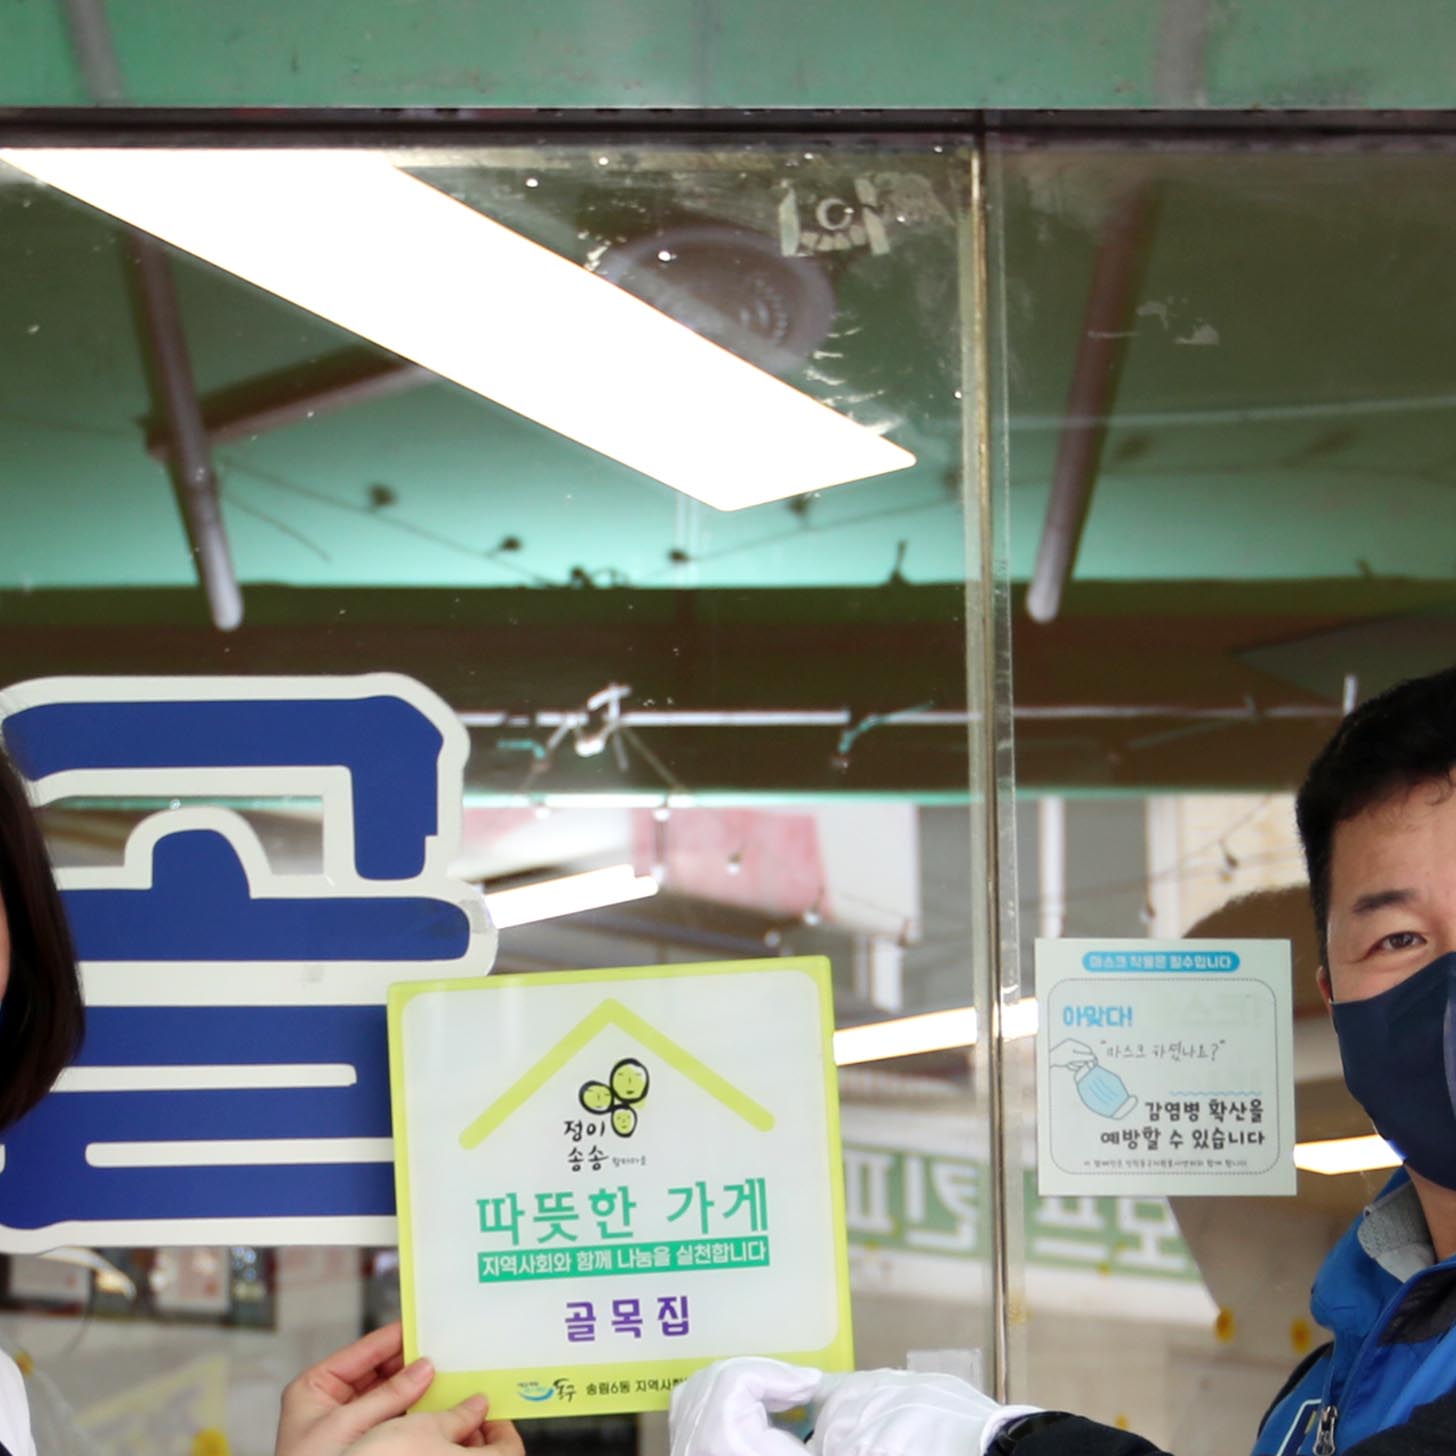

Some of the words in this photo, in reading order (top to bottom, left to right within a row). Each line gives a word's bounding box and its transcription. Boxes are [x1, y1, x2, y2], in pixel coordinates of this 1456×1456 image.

[1144, 1101, 1201, 1123] 감염병
[1208, 1099, 1264, 1124] 확산을
[563, 1119, 606, 1142] 정이
[1100, 1125, 1161, 1151] 예방할
[1169, 1129, 1184, 1149] 수
[1191, 1127, 1265, 1151] 있습니다
[567, 1144, 609, 1173] 송송
[476, 1185, 638, 1246] 따뜻한
[666, 1177, 769, 1236] 가게
[482, 1251, 572, 1277] 지역사회와
[576, 1249, 613, 1272] 함께
[617, 1246, 672, 1270] 나눔을
[675, 1240, 768, 1265] 실천합니다
[564, 1295, 690, 1343] 골목집
[585, 1381, 632, 1396] 송림6동
